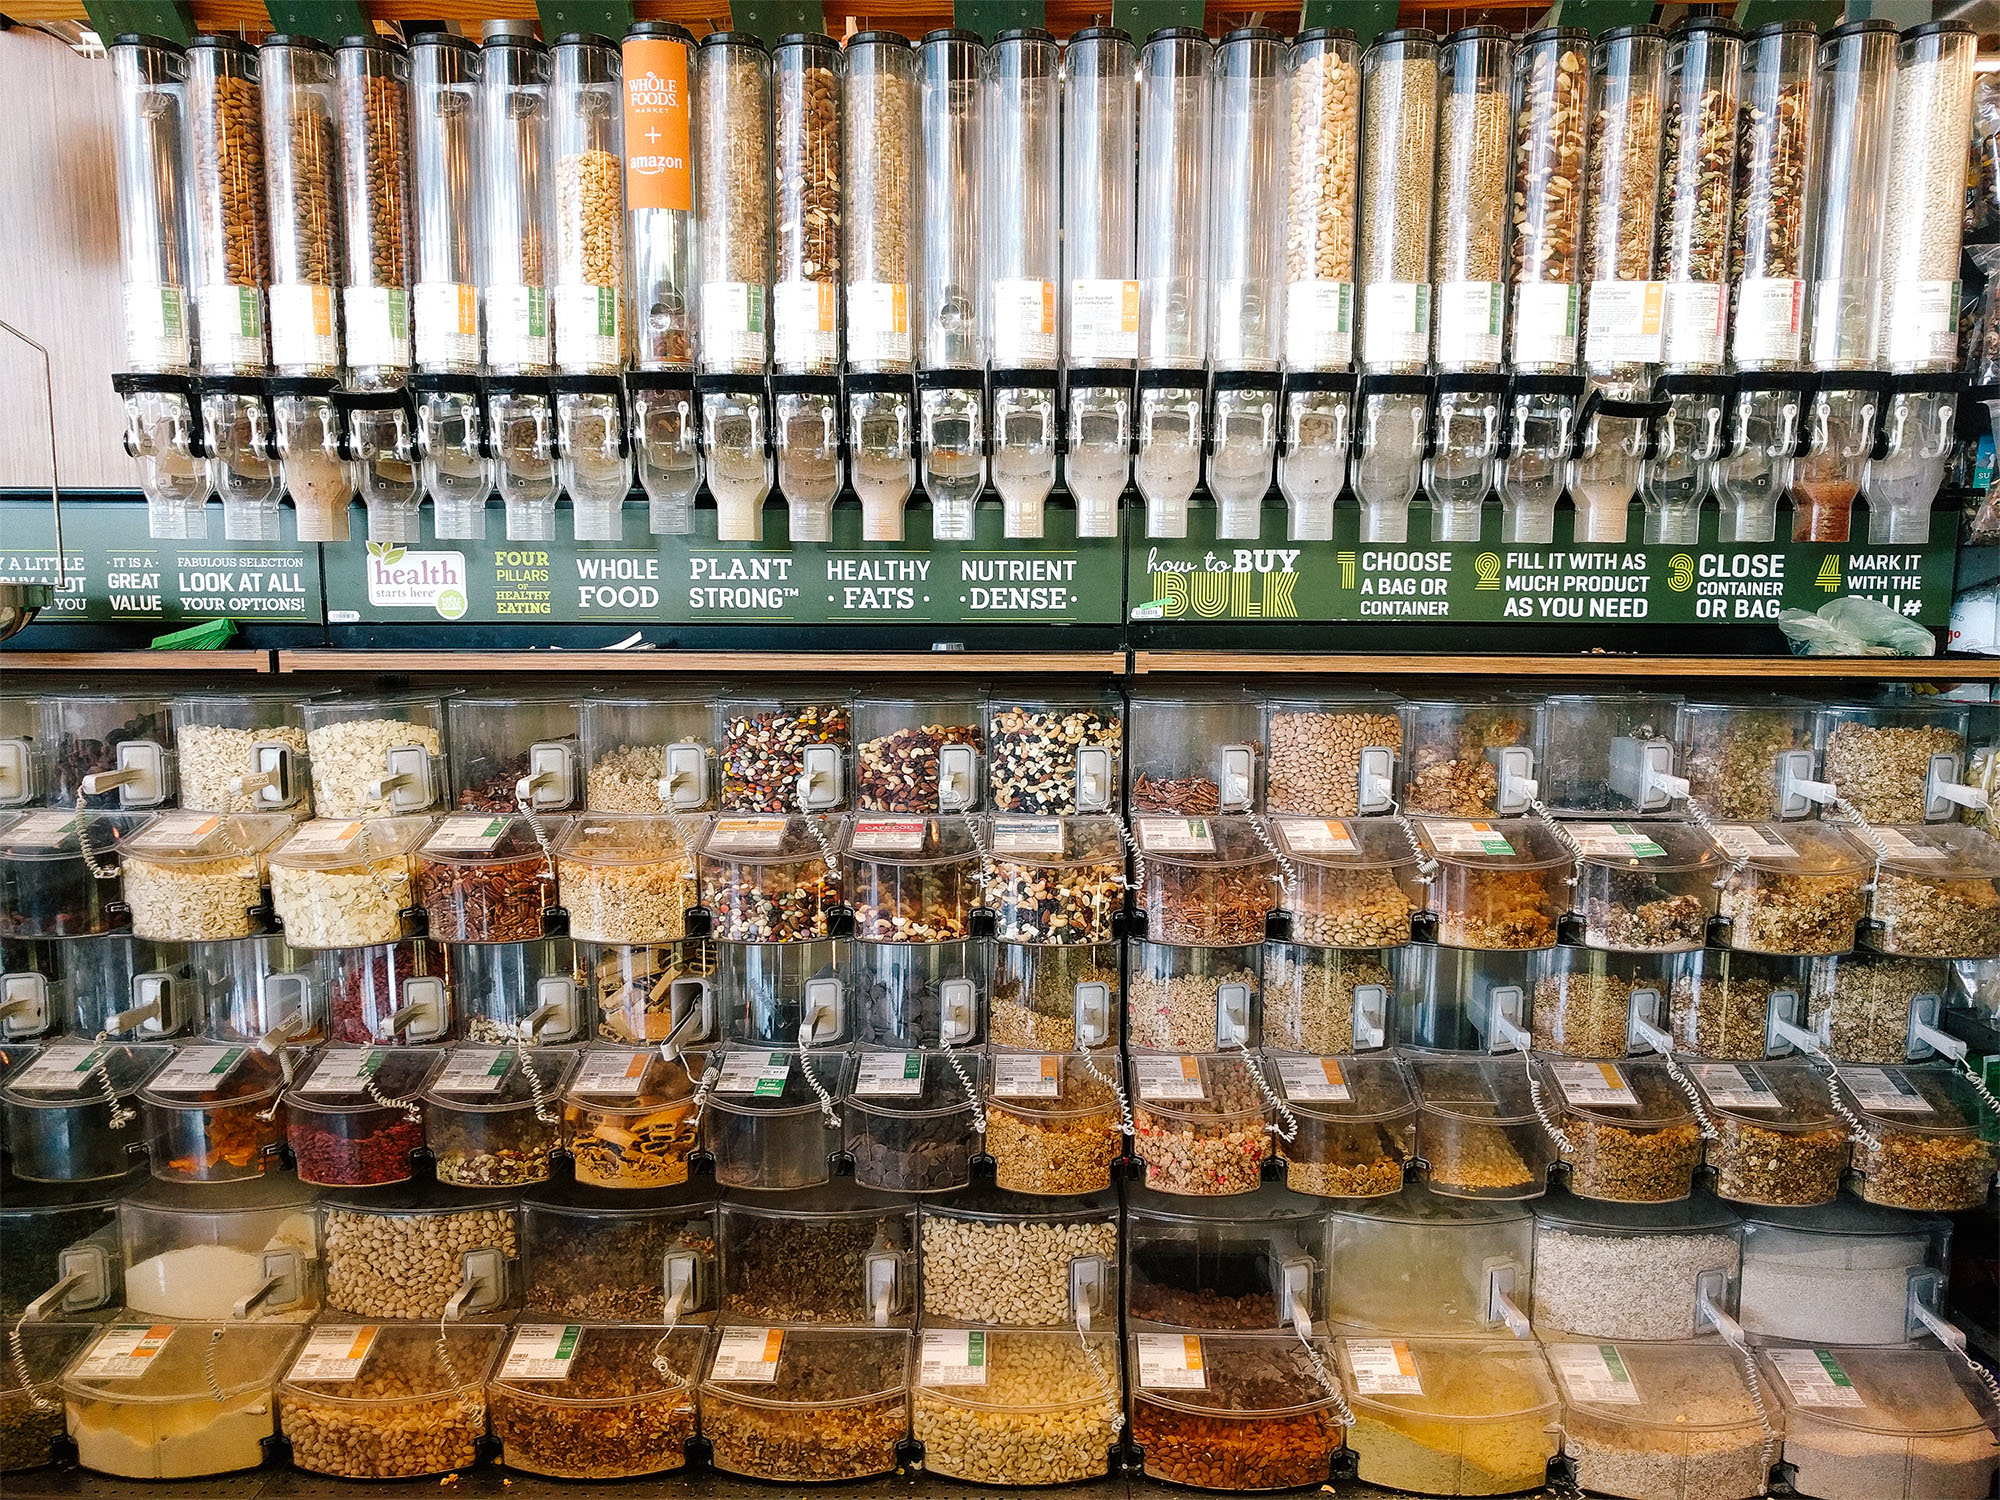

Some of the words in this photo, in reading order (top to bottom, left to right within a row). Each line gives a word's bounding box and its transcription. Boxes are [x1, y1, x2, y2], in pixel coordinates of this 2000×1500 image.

[628, 77, 677, 93] WHOLE
[630, 92, 677, 106] FOODS
[630, 155, 683, 170] amazon
[8, 557, 22, 571] A
[24, 557, 85, 571] LITTLE
[113, 557, 125, 568] IT
[128, 557, 141, 568] IS
[144, 557, 153, 568] A
[177, 557, 237, 568] FABULOUS
[239, 557, 304, 568] SELECTION
[494, 551, 550, 566] FOUR
[1146, 546, 1198, 574] how
[1203, 550, 1232, 573] to
[1232, 549, 1300, 573] BUY
[1362, 551, 1452, 572] CHOOSE
[1506, 553, 1544, 569] FILL
[1548, 553, 1566, 569] IT
[1568, 553, 1618, 570] WITH
[1621, 553, 1646, 570] AS
[1699, 553, 1785, 578] CLOSE
[1848, 554, 1901, 570] MARK
[1905, 554, 1922, 570] IT
[375, 559, 458, 585] health
[496, 569, 549, 582] PILLARS
[576, 558, 659, 580] WHOLE
[689, 558, 793, 580] PLANT
[827, 560, 931, 581] HEALTHY
[961, 560, 1077, 581] NUTRIENT
[1337, 551, 1356, 589] 1
[1474, 551, 1501, 591] 2
[1667, 553, 1694, 592] 3
[1814, 554, 1842, 592] 4
[107, 573, 160, 589] GREAT
[178, 572, 235, 592] LOOK
[239, 572, 264, 592] AT
[268, 572, 306, 592] ALL
[1360, 578, 1374, 595] A
[1378, 578, 1416, 595] BAG
[1420, 578, 1448, 595] OR
[1505, 575, 1560, 592] MUCH
[1563, 576, 1650, 592] PRODUCT
[1697, 581, 1784, 596] CONTAINER
[1847, 576, 1888, 590] WITH
[1891, 576, 1922, 590] THE
[376, 587, 406, 598] starts
[496, 591, 551, 600] HEALTHY
[578, 586, 659, 608] FOOD
[843, 587, 914, 609] FATS
[969, 587, 1067, 609] DENSE
[1153, 571, 1300, 618] BULK
[54, 598, 87, 611] YOU
[109, 595, 162, 611] VALUE
[180, 597, 226, 611] YOUR
[229, 597, 306, 612] OPTIONS!
[496, 602, 551, 615] EATING
[1360, 601, 1449, 616] CONTAINER
[1503, 597, 1533, 617] AS
[1538, 597, 1584, 617] YOU
[1589, 597, 1649, 618] NEED
[1696, 598, 1727, 618] OR
[1734, 598, 1781, 618] BAG
